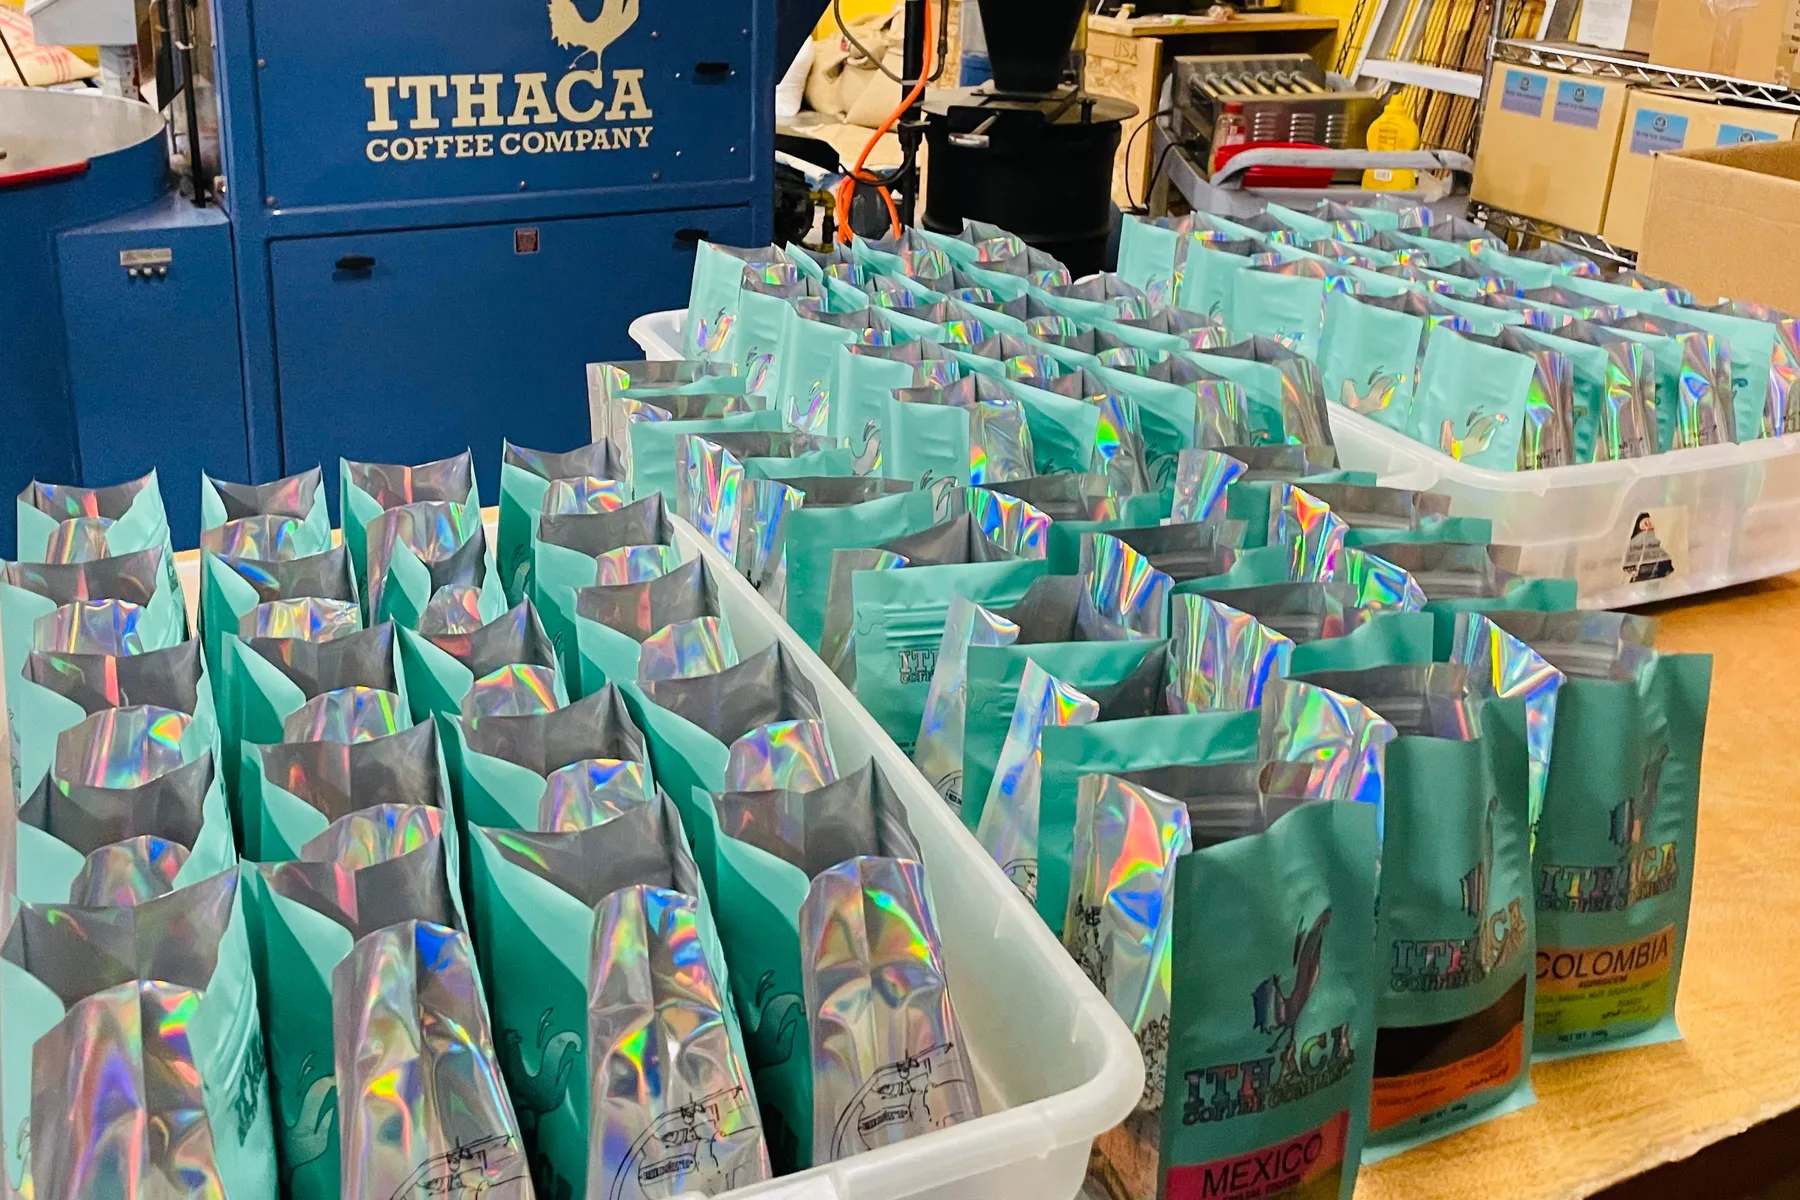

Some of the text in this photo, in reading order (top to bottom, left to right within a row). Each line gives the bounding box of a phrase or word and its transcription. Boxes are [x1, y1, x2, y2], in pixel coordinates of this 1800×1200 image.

[365, 69, 653, 131] ITHACA
[366, 126, 653, 162] COFFEE COMPANY
[1536, 934, 1668, 979] COLOMBIA
[1184, 1023, 1354, 1102] ITHACA
[1202, 1133, 1323, 1198] MEXICO
